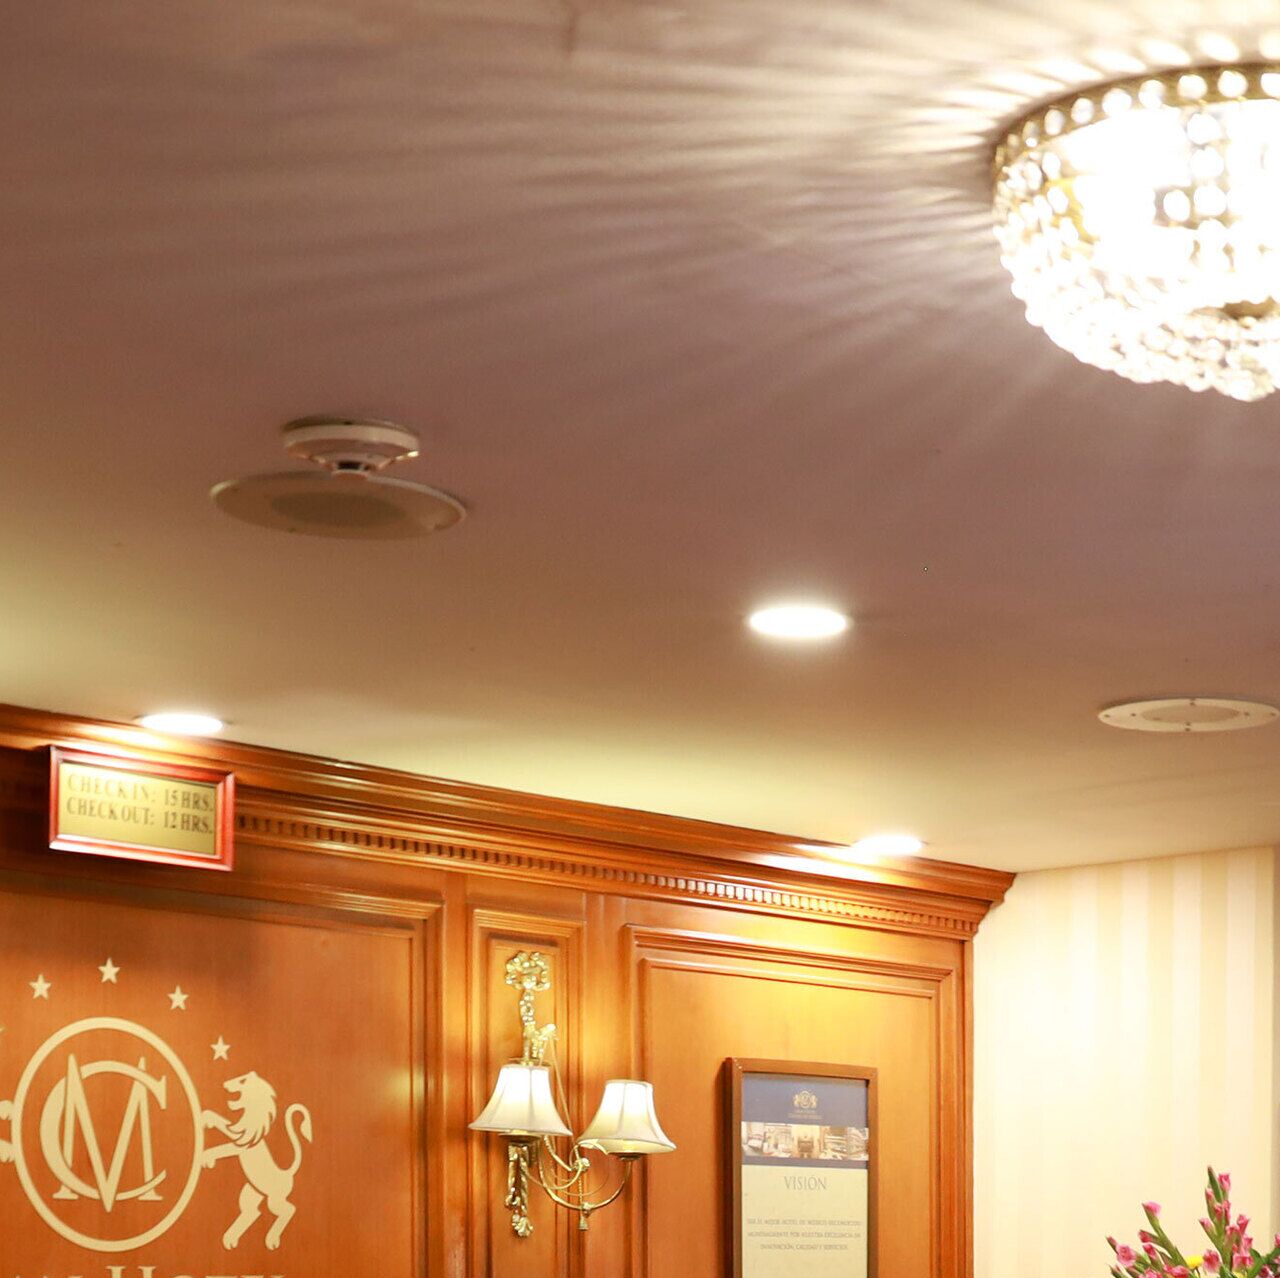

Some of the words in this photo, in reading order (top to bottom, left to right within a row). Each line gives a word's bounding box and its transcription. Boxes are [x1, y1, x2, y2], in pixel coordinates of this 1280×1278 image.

[67, 774, 127, 799] CHECK
[164, 788, 178, 807] 15
[180, 790, 214, 812] HRS.
[163, 810, 177, 829] 12
[180, 812, 214, 835] HRS.
[783, 1174, 828, 1191] VISIÓN
